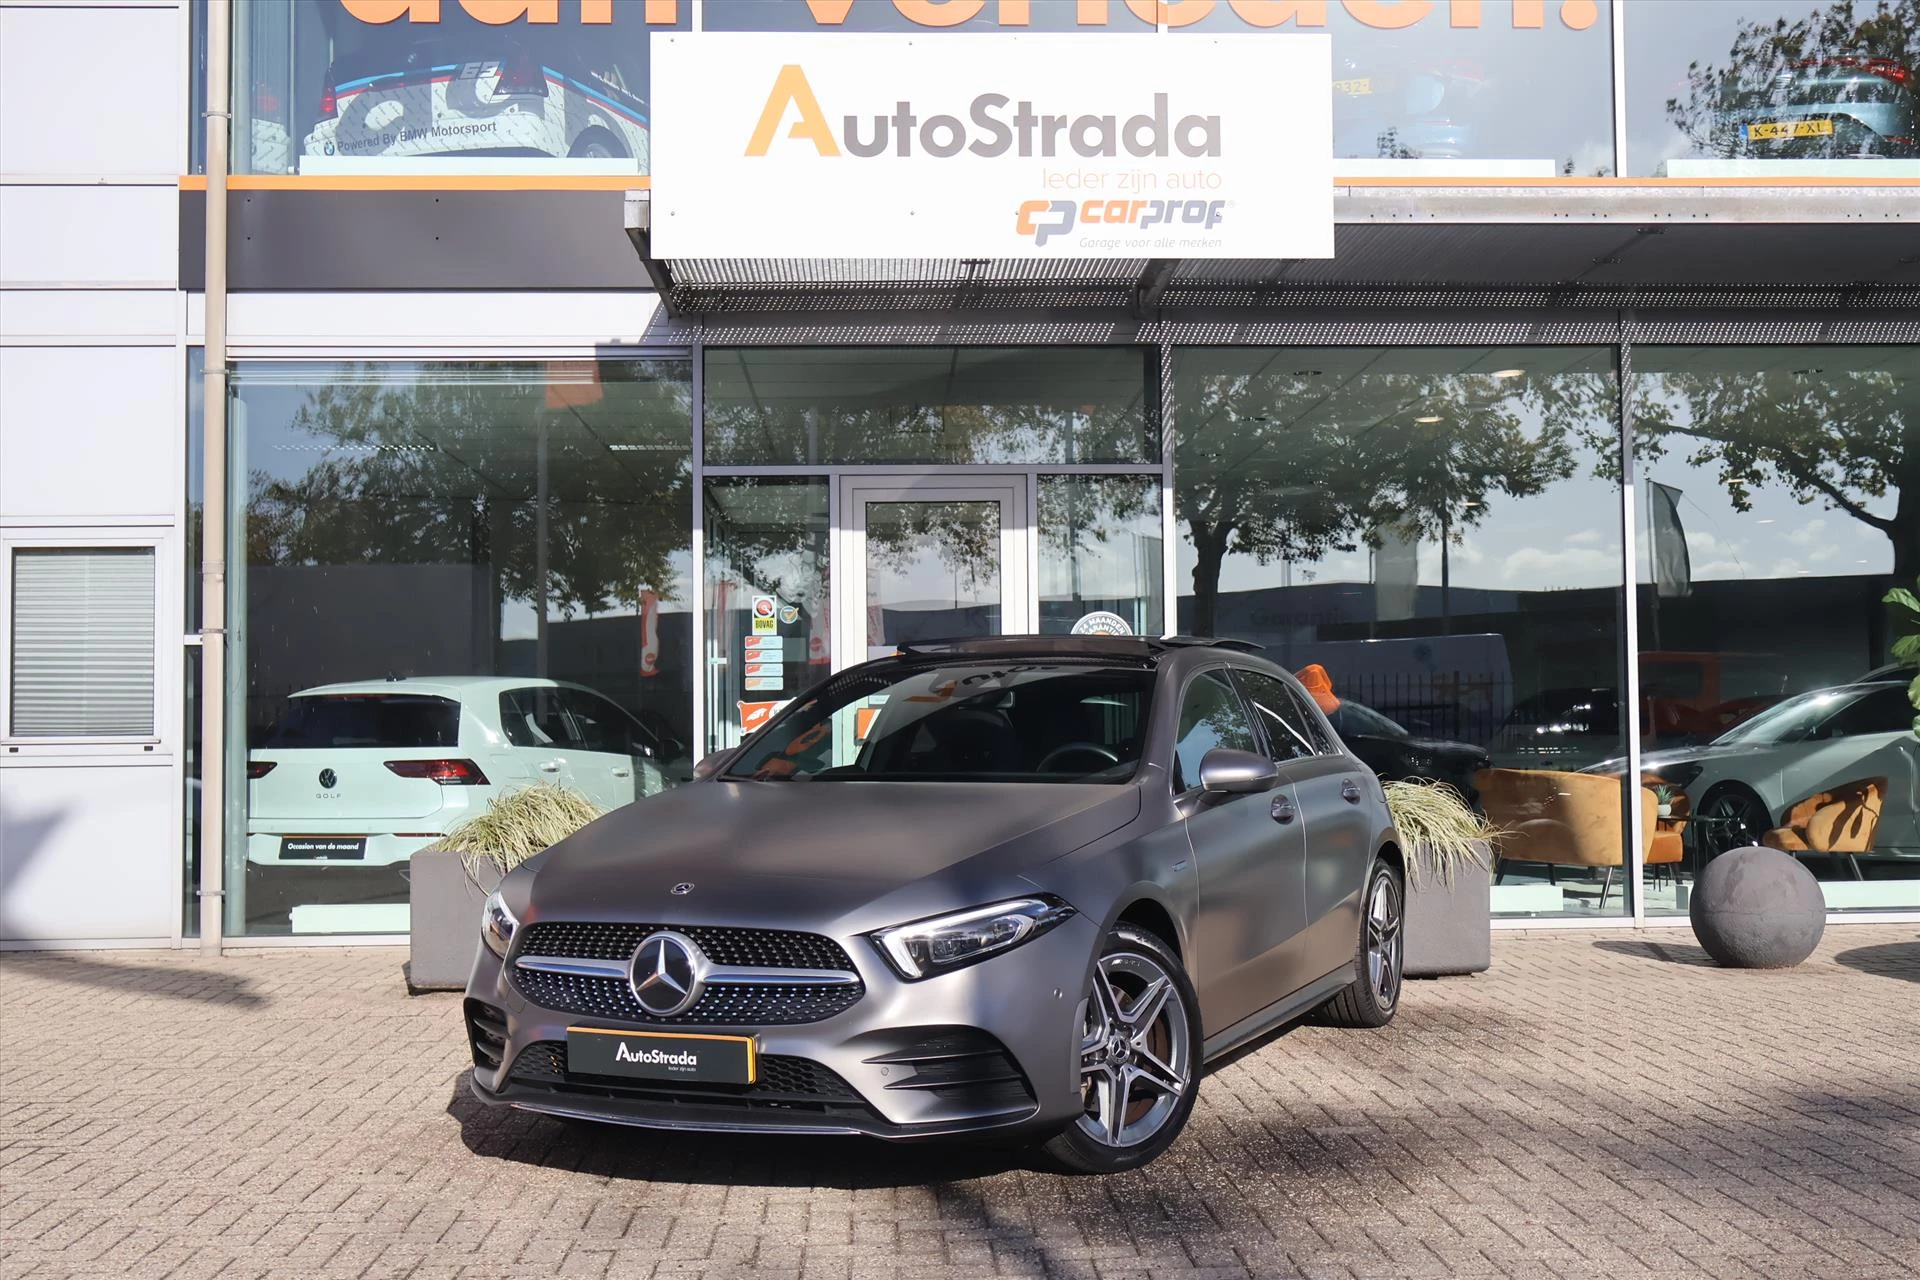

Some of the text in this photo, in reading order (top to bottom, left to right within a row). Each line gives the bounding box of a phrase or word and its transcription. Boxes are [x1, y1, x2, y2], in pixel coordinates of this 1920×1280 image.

[744, 64, 1222, 158] AutoStrada
[337, 121, 497, 152] Powered By BMW Motorsport
[1042, 168, 1222, 194] Ieder zijn auto
[1079, 236, 1222, 250] Garage voor alle merken
[755, 620, 774, 629] BOVAG
[1088, 616, 1125, 634] MAANDEN
[287, 842, 314, 850] Occasion
[328, 842, 336, 850] de
[337, 842, 360, 850] maand
[616, 1041, 697, 1066] AutoStrada
